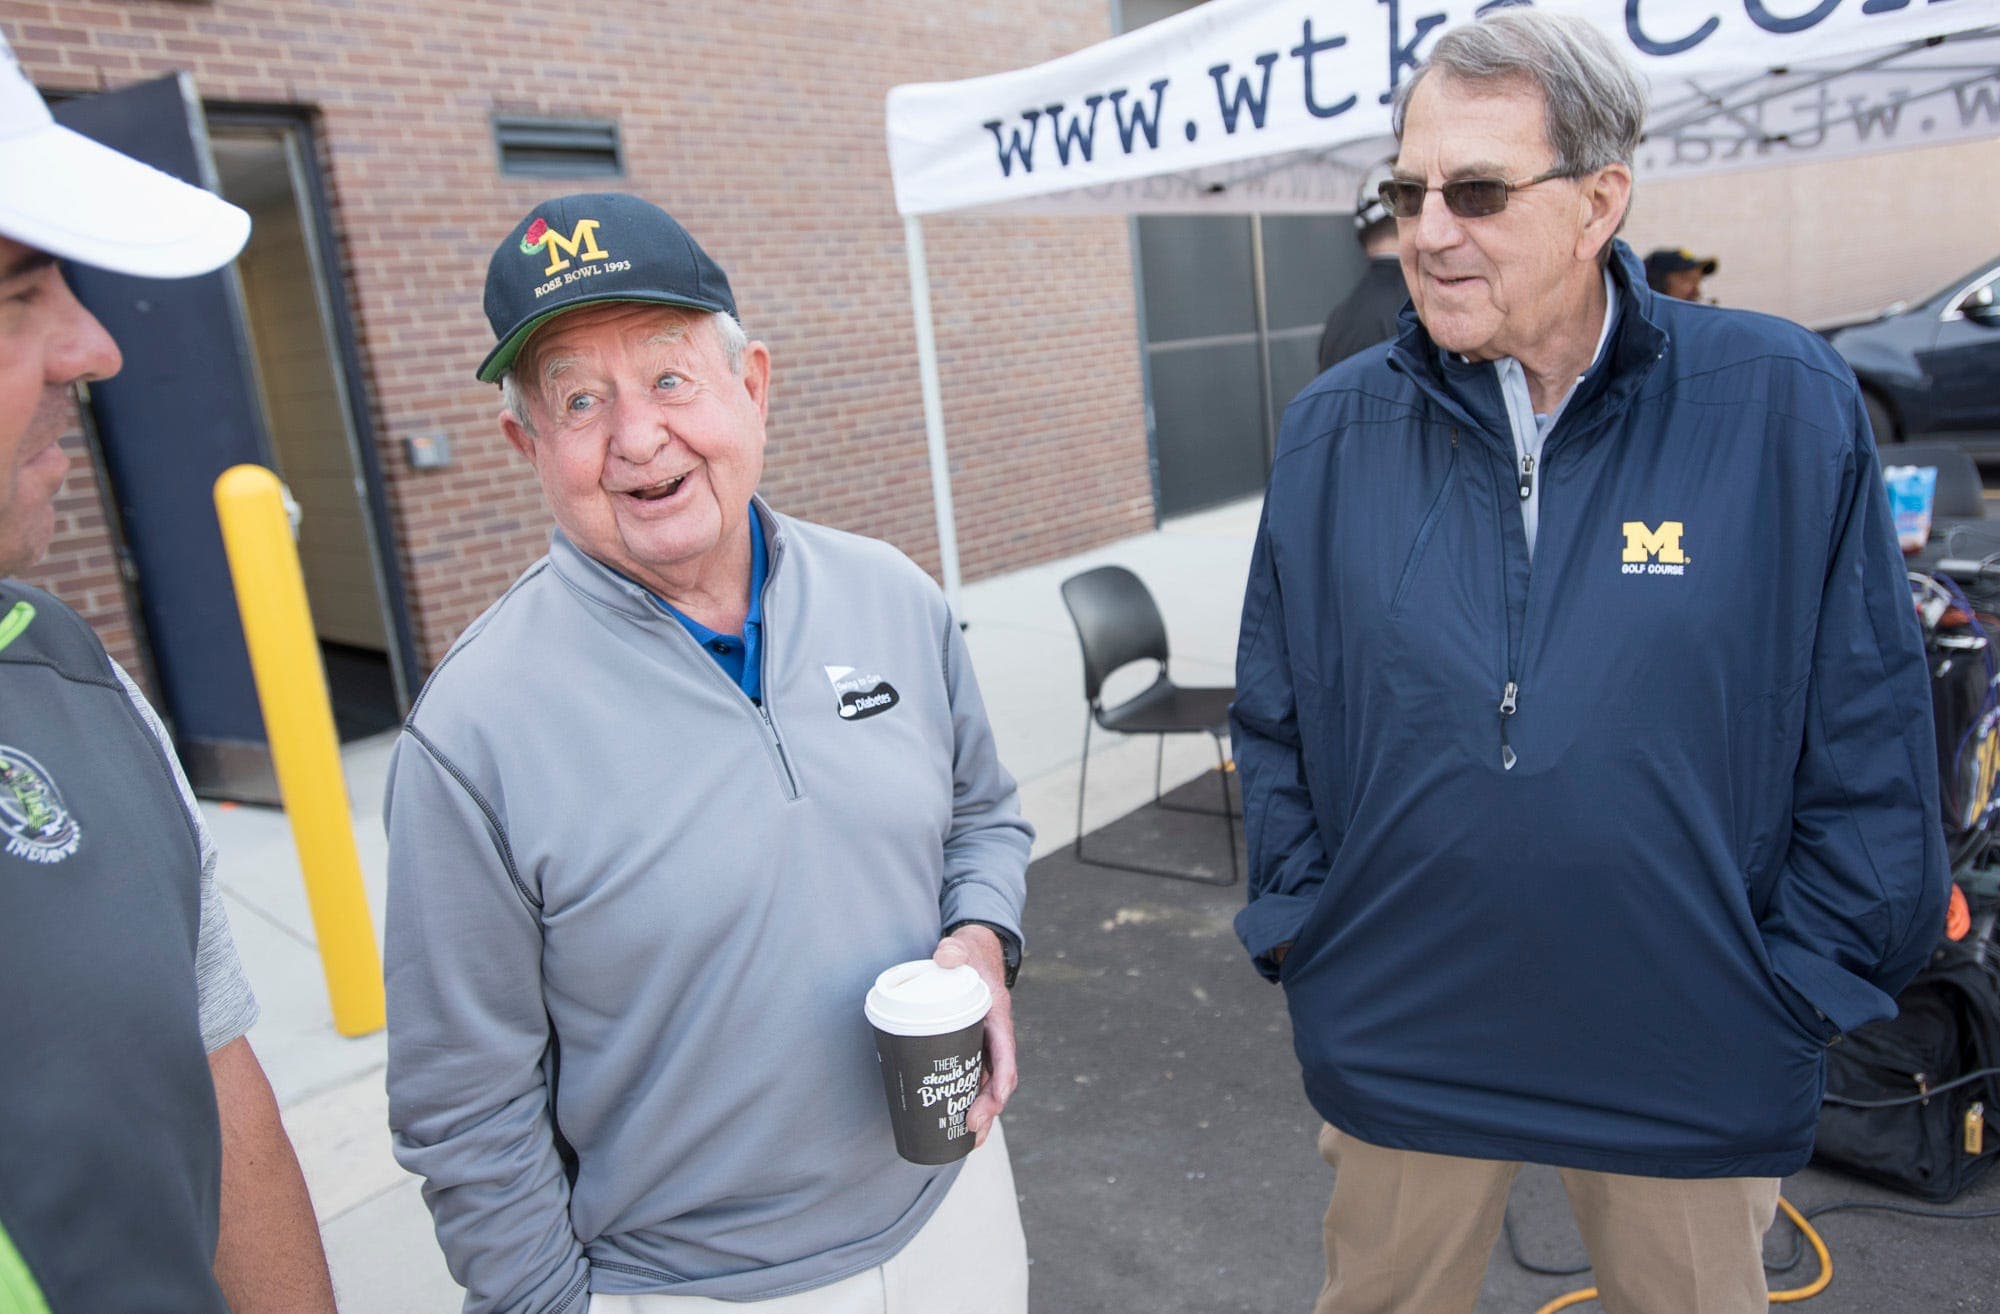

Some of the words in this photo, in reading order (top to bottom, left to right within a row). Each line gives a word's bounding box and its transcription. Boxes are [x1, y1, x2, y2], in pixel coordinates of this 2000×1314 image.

[539, 218, 609, 276] M
[534, 276, 563, 298] ROSE
[564, 264, 602, 284] BOWL
[604, 260, 632, 273] 1993
[1622, 521, 1684, 563] M
[1621, 564, 1646, 574] GOLF
[1647, 564, 1684, 575] COURSE
[855, 693, 892, 712] Diabetes
[932, 1055, 960, 1072] THERE
[922, 1065, 964, 1085] should
[938, 1117, 947, 1129] IN
